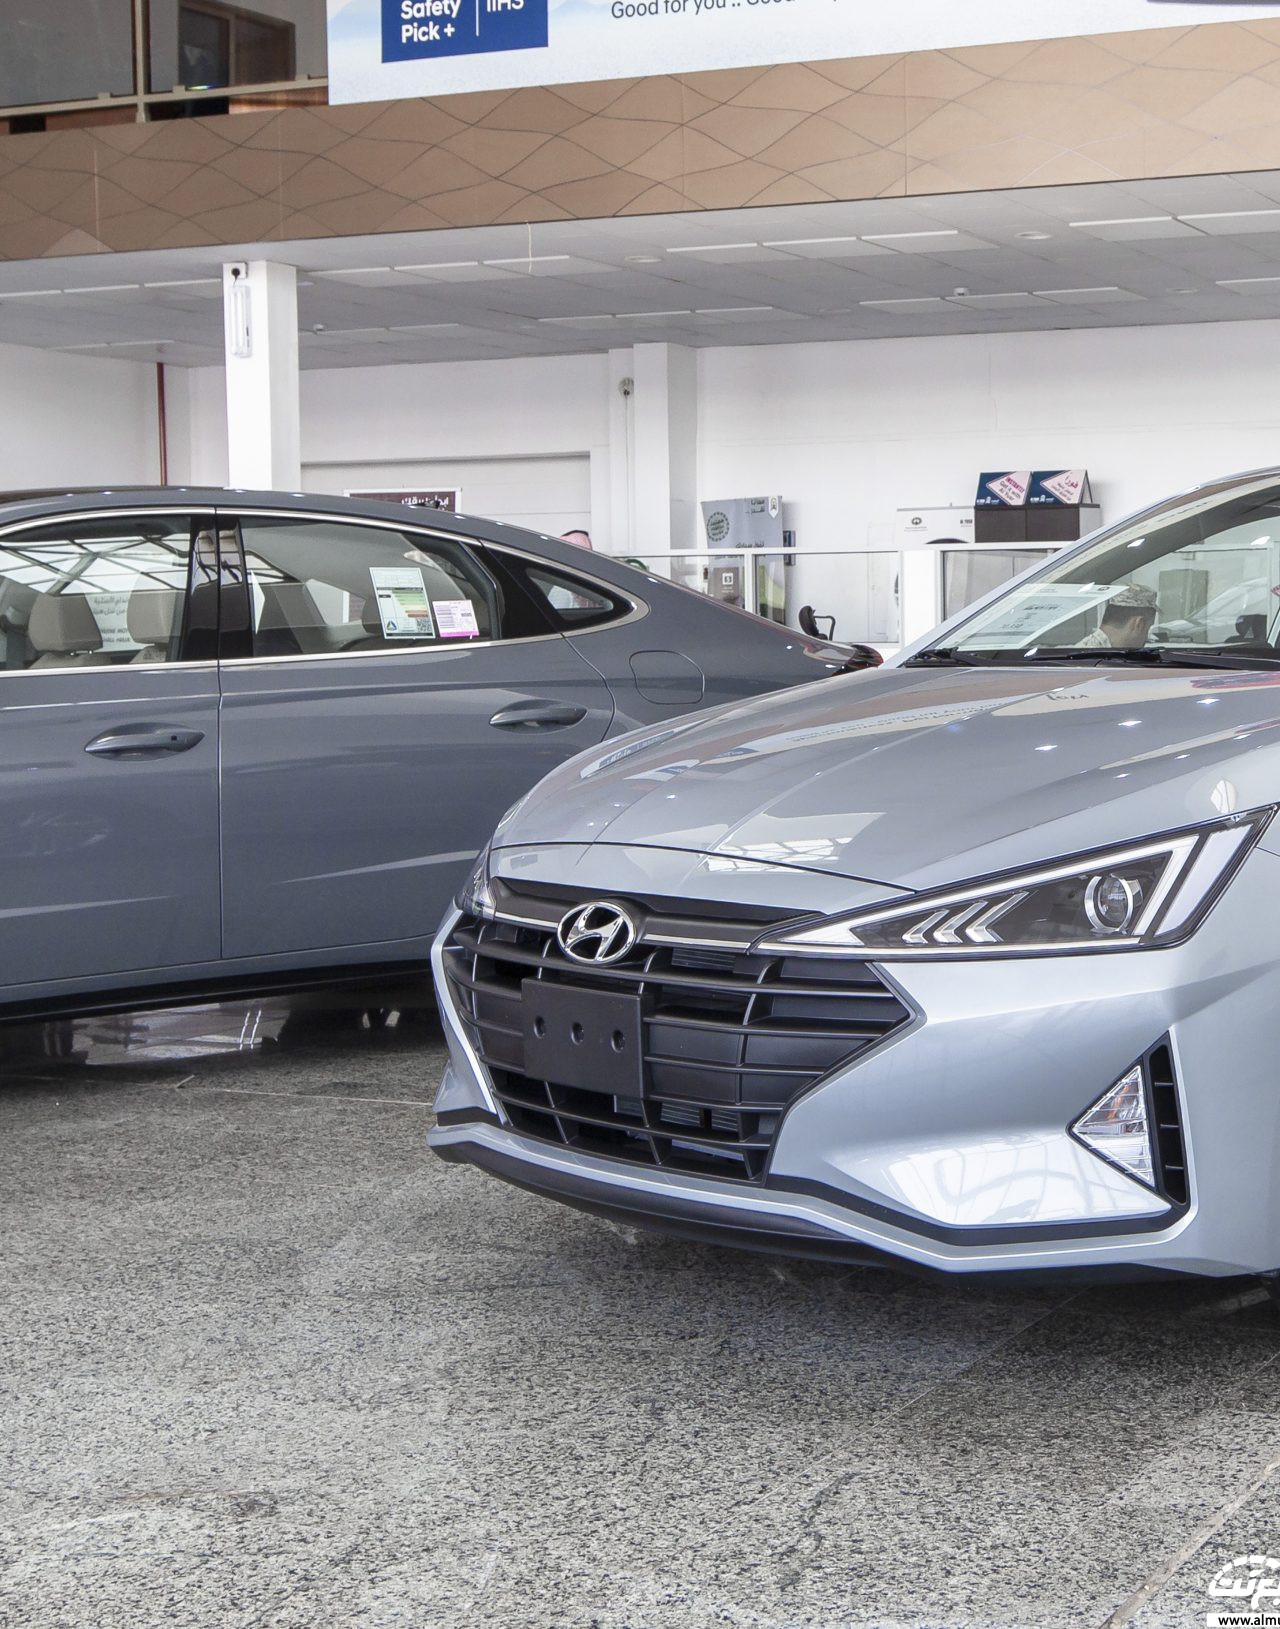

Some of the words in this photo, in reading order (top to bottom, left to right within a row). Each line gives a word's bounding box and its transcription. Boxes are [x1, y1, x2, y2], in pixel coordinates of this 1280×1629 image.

[401, 0, 461, 19] Safety
[611, 0, 659, 18] Good
[664, 0, 687, 13] for
[695, 0, 725, 15] you
[402, 21, 440, 43] Pick
